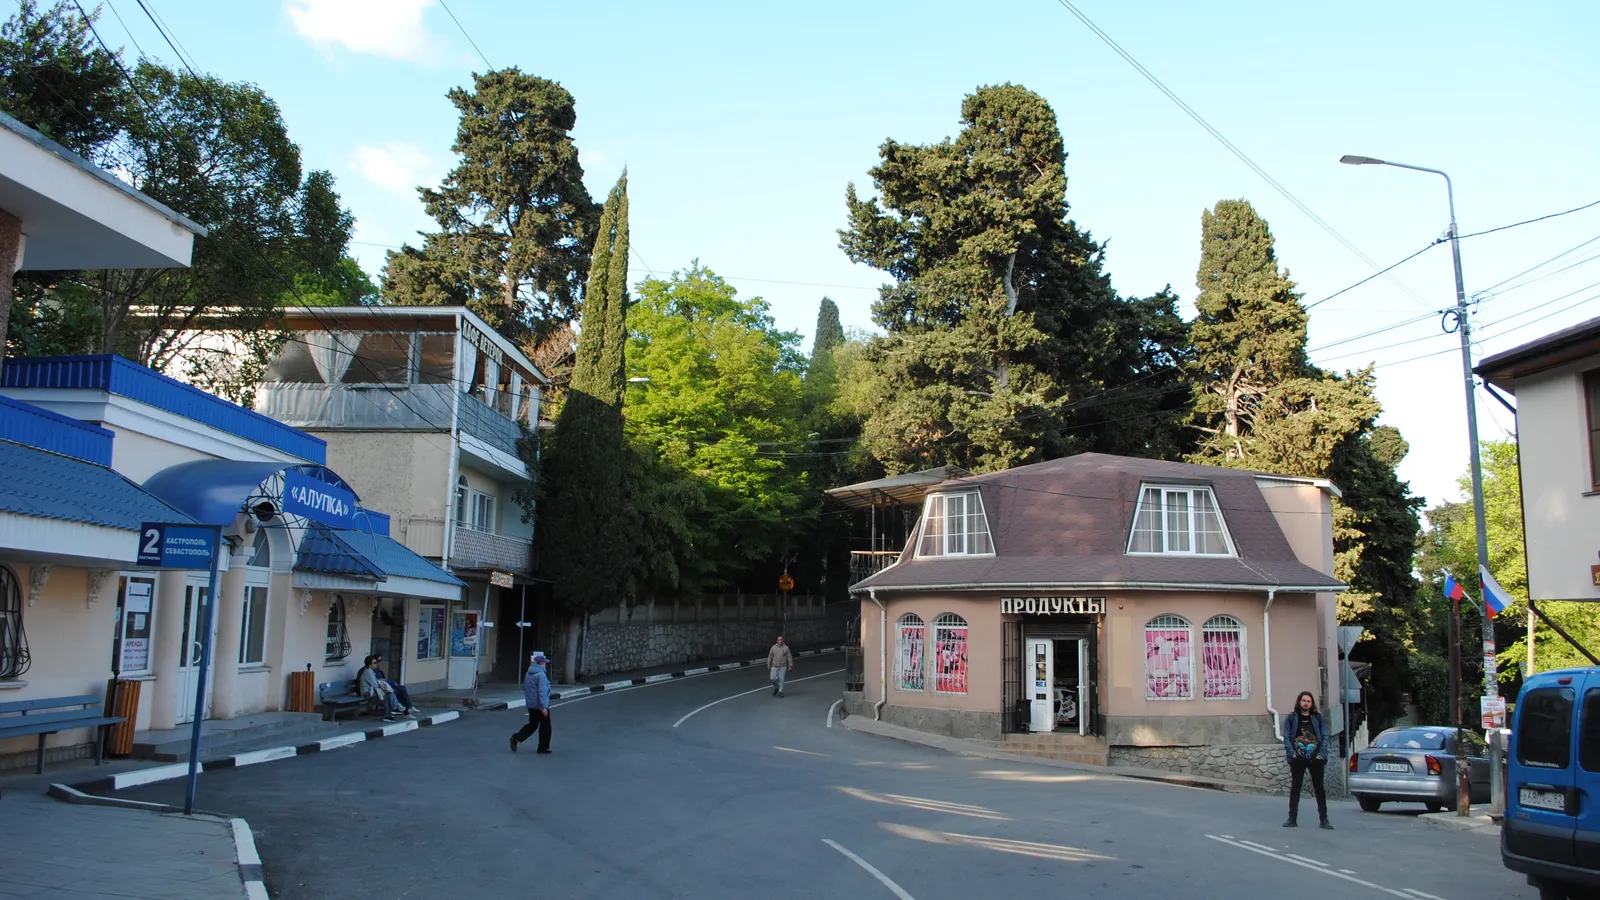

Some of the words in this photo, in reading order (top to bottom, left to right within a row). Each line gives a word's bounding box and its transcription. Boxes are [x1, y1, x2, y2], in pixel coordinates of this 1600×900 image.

[462, 319, 480, 348] КАФЕ
[291, 486, 349, 517] «АЛУПКА»
[143, 528, 160, 554] 2
[165, 547, 210, 556] СЕВАСТОПОЛЬ
[166, 537, 207, 546] КАСТРОПОЛЬ
[1001, 597, 1106, 616] ПРОДУКТЫ
